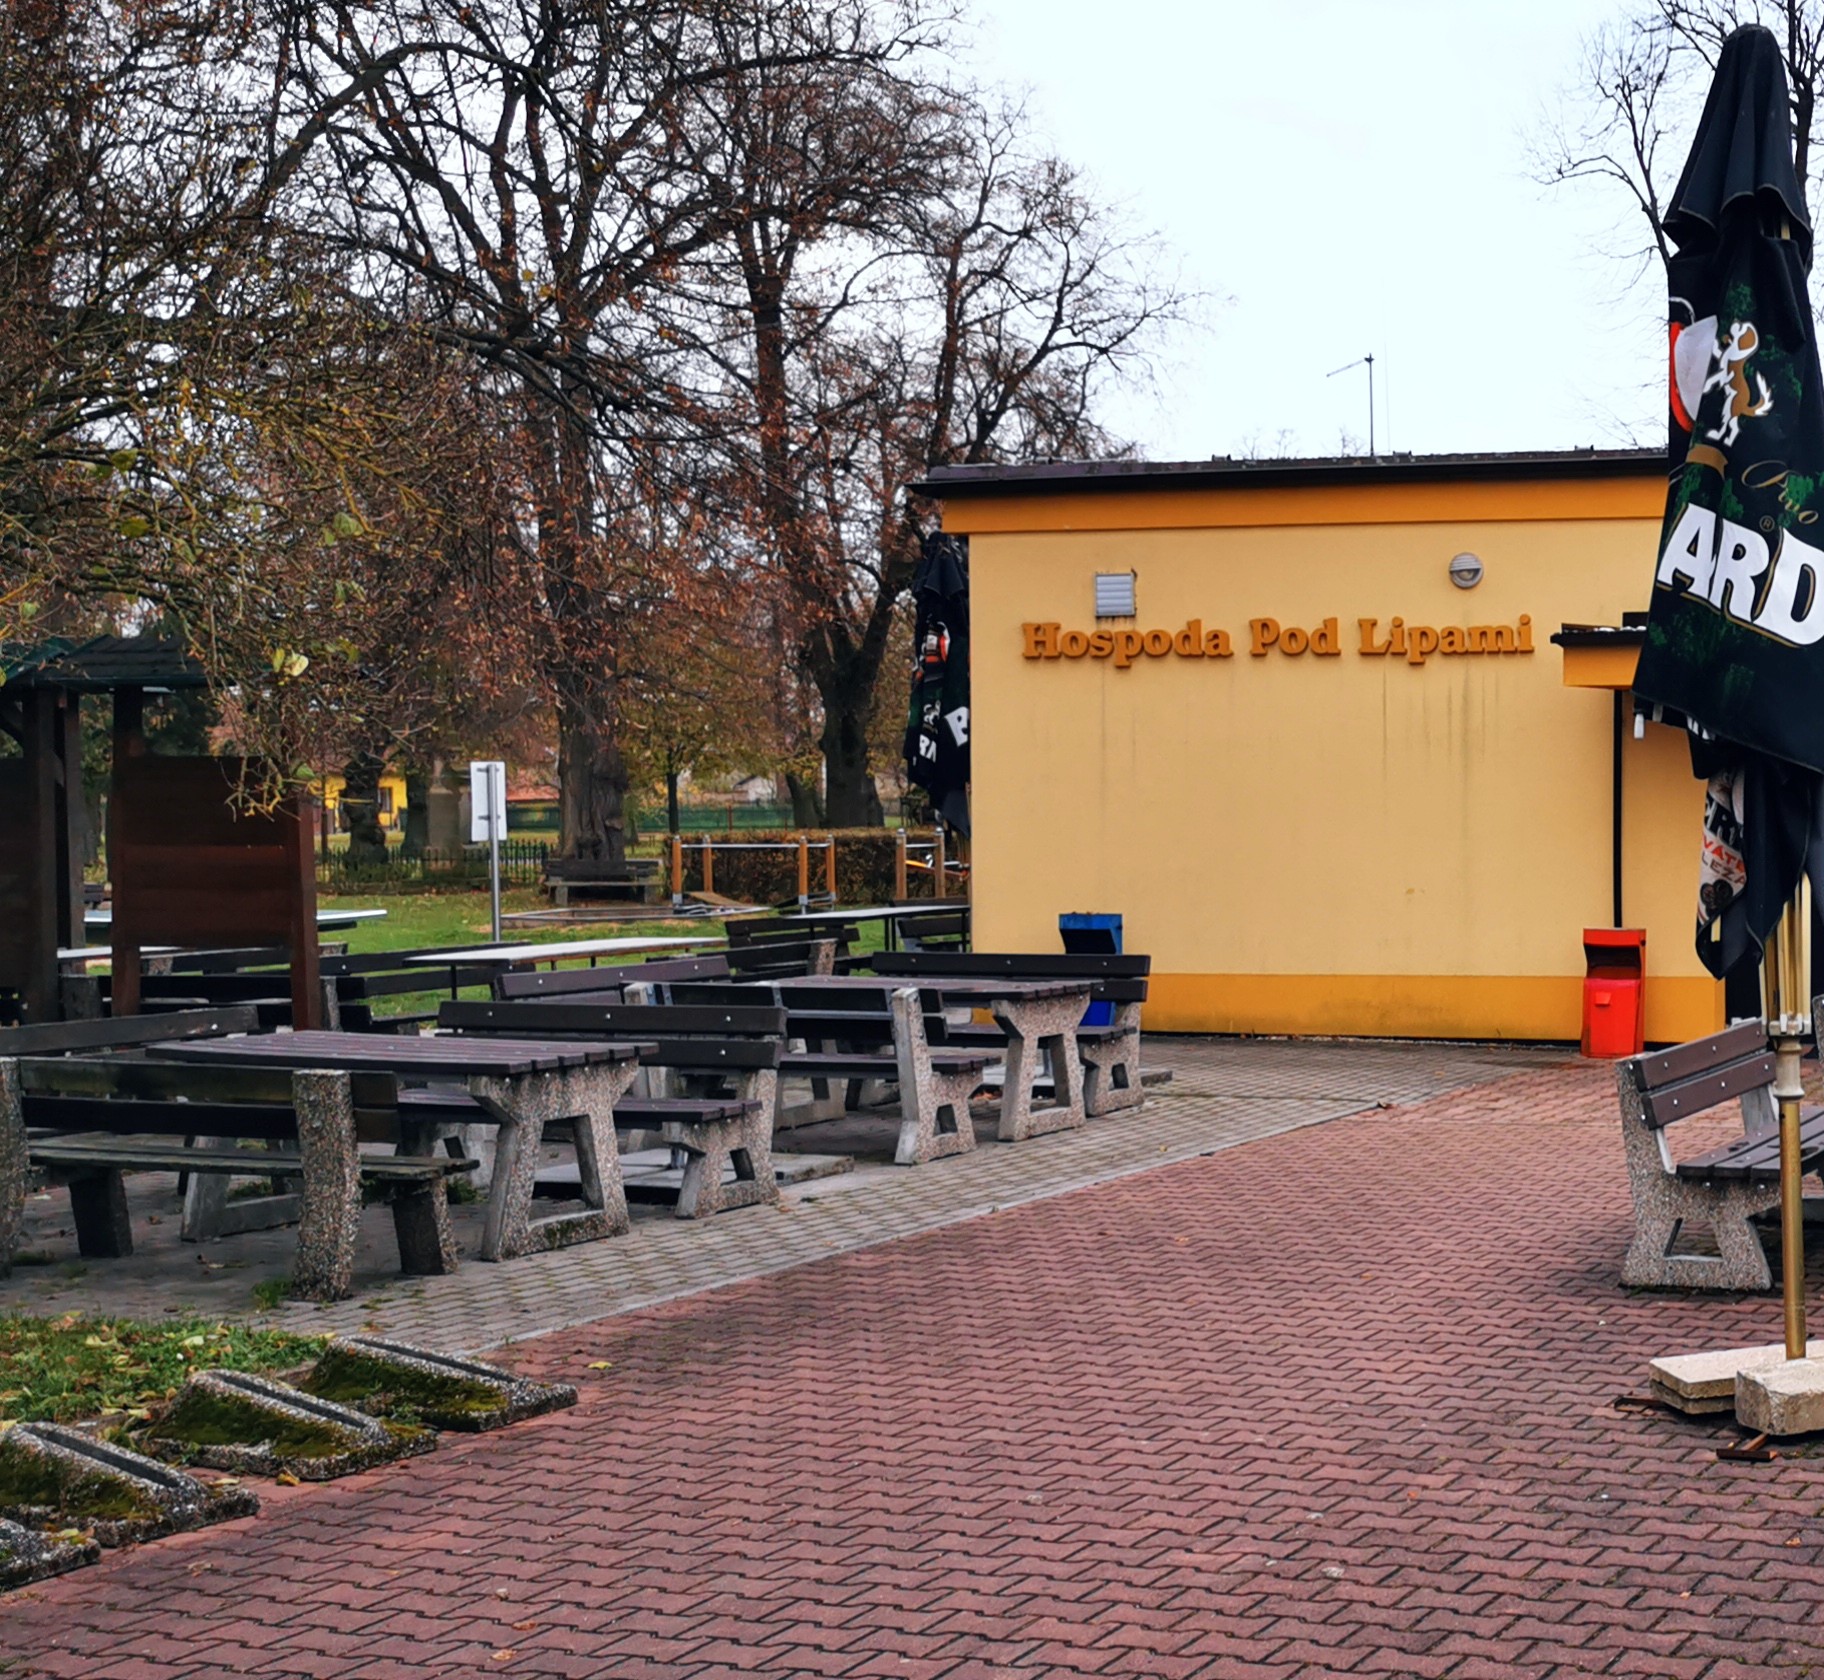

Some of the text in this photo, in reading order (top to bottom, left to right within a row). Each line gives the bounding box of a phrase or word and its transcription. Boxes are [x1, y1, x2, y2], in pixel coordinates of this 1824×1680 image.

[1021, 614, 1535, 668] Hospoda Pod Lipami
